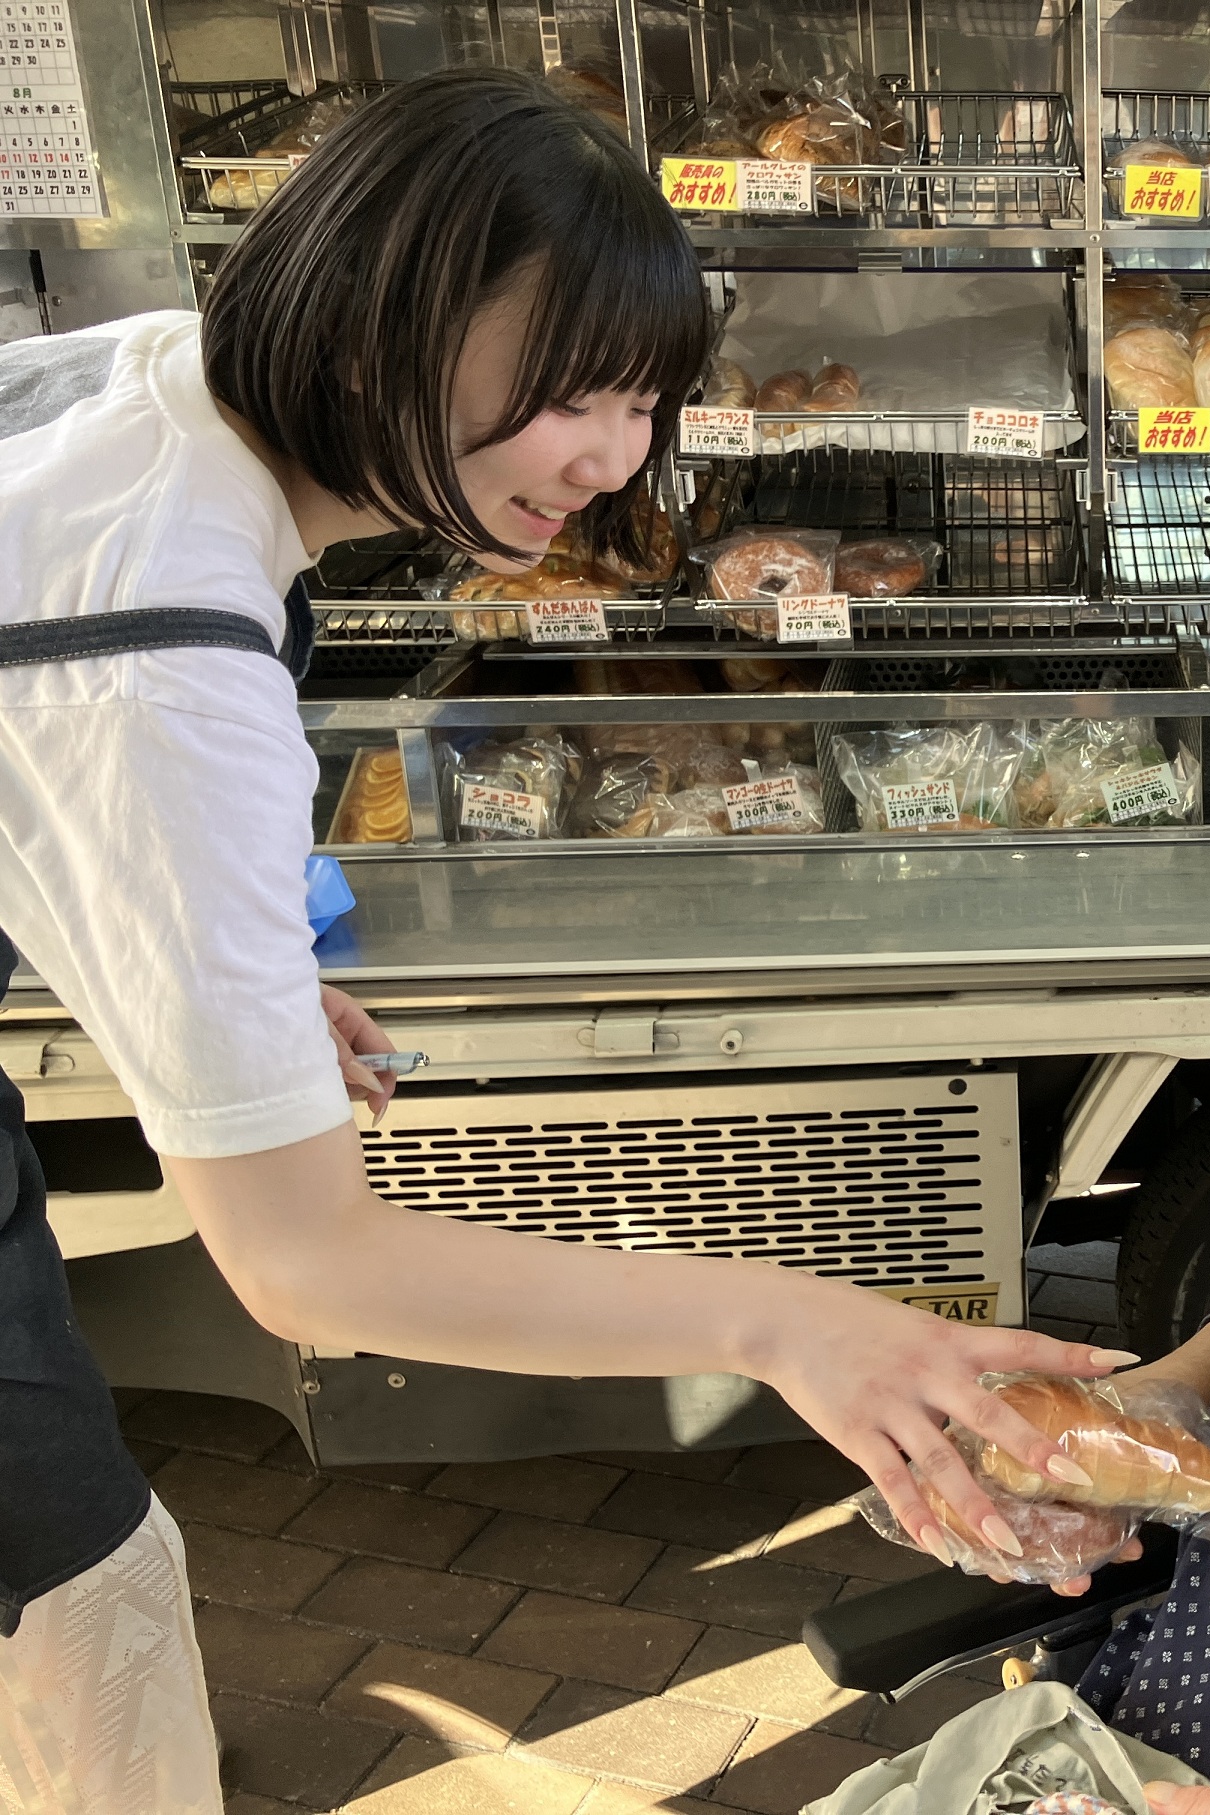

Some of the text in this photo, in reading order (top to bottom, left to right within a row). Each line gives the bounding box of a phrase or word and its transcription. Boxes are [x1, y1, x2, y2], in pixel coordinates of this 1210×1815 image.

[21, 6, 27, 15] 9
[35, 5, 45, 15] 10
[51, 5, 60, 15] 11
[7, 22, 63, 32] 15 16 17 18
[9, 39, 19, 48] 22
[24, 39, 34, 48] 23
[40, 38, 51, 48] 24
[56, 38, 66, 48] 25
[11, 56, 21, 65] 29
[27, 55, 37, 65] 30
[13, 88, 32, 98] 8月
[4, 104, 76, 114] 火 水 木 金 土
[12, 138, 17, 147] 4
[27, 138, 33, 147] 5
[43, 138, 48, 147] 6
[59, 137, 64, 146] 7
[75, 137, 80, 147] 8
[12, 153, 22, 163] 11
[28, 153, 38, 163] 12
[44, 153, 54, 163] 13
[60, 153, 70, 162] 14
[75, 153, 85, 162] 15
[679, 164, 724, 178] 販売員の
[742, 162, 806, 171] アールグレイの
[1, 169, 88, 179] 17 18 19 20 21 22
[747, 171, 802, 180] クロワッサン
[1147, 171, 1178, 186] 当店
[3, 185, 91, 195] 24 25 26 27 28 29
[670, 182, 736, 204] おすすめ！
[1130, 187, 1196, 211] おすすめ！
[5, 201, 15, 211] 31
[684, 410, 749, 425] ミルキーフランス
[973, 411, 1039, 428] チョココロネ
[1154, 410, 1196, 424] 当店
[1145, 426, 1208, 448] おすすめ！
[532, 600, 598, 615] ずんだあんぱん
[782, 598, 845, 611] リングドーナツ
[726, 778, 794, 800] マンゴーの生ドーナツ
[887, 782, 950, 800] フィッシュサンド
[473, 787, 531, 808] ショコラ
[906, 1298, 988, 1320] TAR
